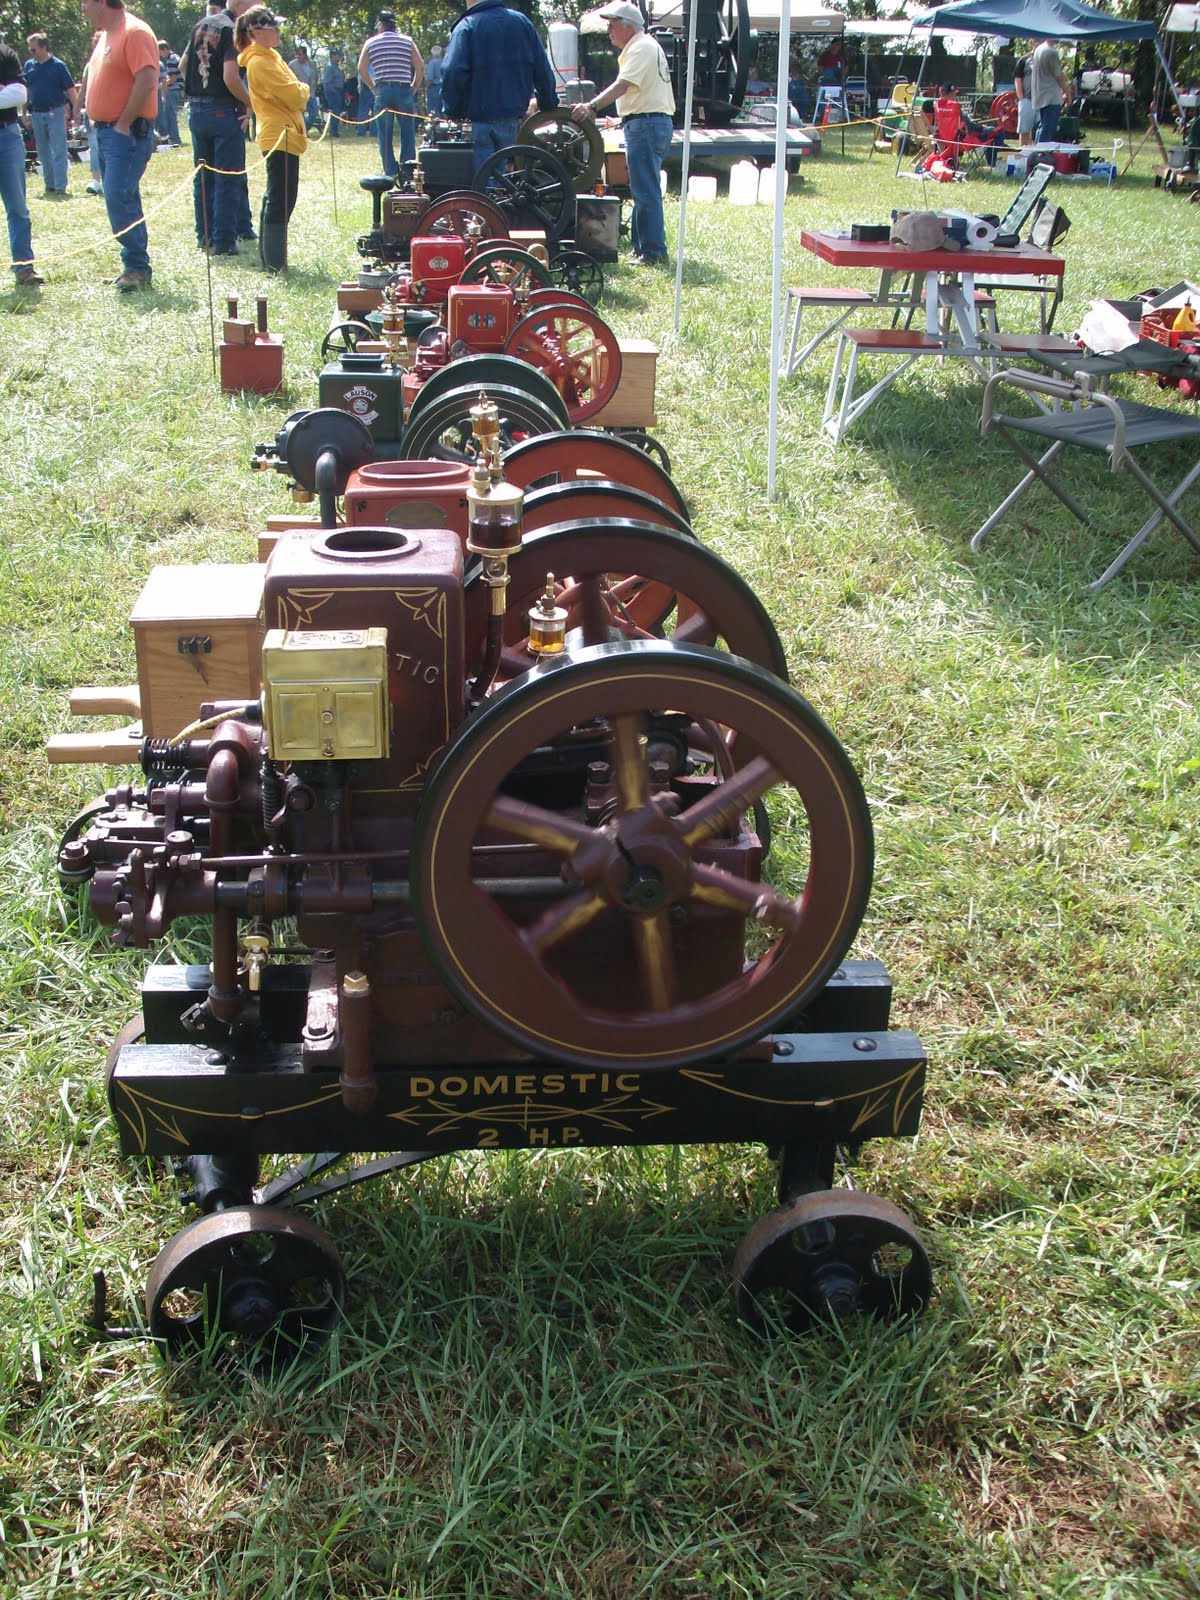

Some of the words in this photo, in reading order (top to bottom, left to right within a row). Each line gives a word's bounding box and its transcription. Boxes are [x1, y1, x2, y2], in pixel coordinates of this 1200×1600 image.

[344, 389, 376, 401] LAUSON
[395, 653, 439, 684] TIC
[410, 1073, 641, 1097] DOMESTIC
[477, 1128, 500, 1147] 2
[529, 1126, 584, 1145] H.P.
